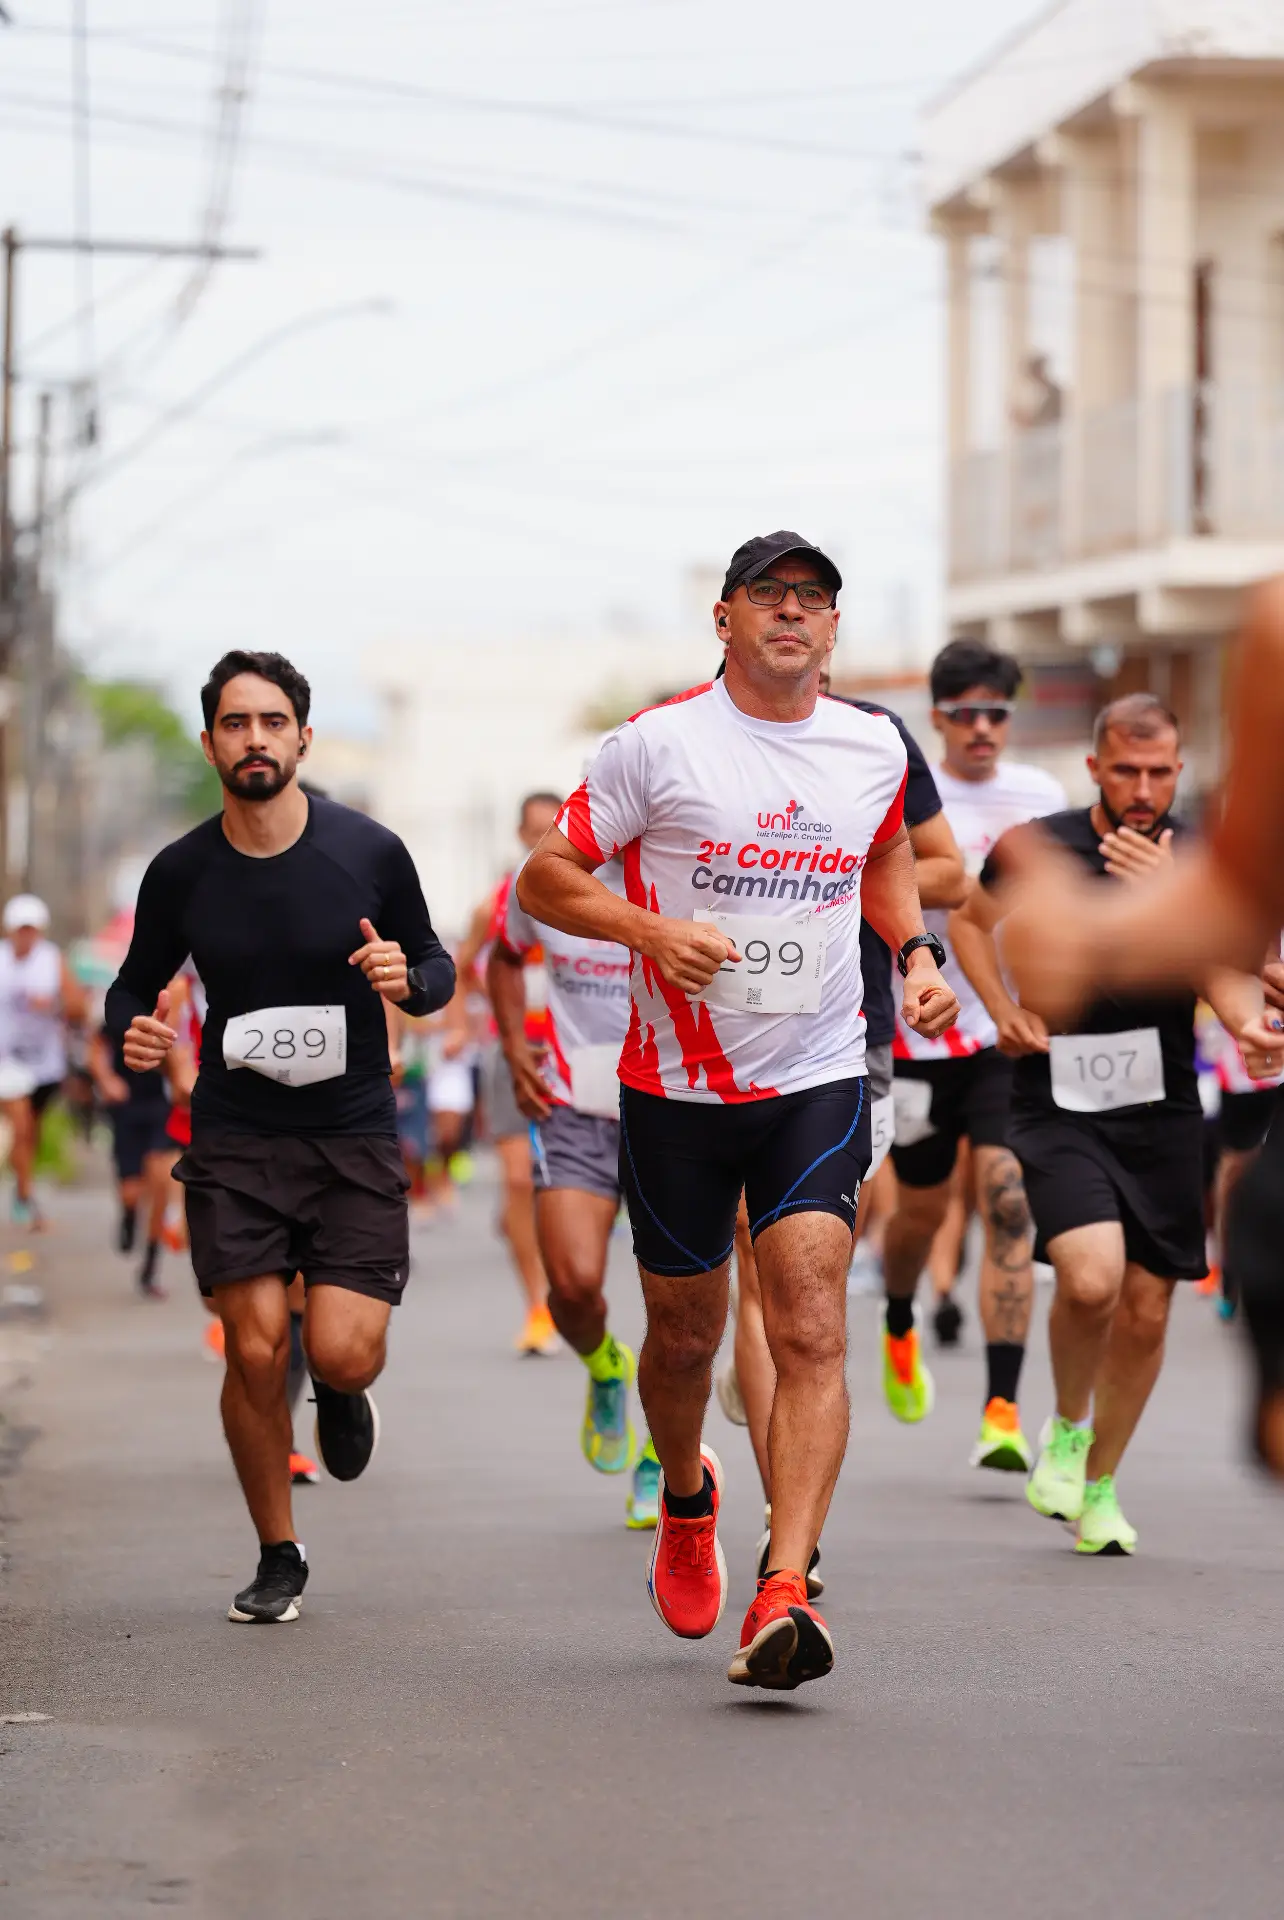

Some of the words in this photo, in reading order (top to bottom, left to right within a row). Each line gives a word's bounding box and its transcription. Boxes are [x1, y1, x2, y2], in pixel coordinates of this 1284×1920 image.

[770, 831, 793, 841] Felipe
[801, 833, 832, 842] Cruvinel
[737, 844, 859, 874] Corrida
[243, 1028, 326, 1060] 289
[1073, 1049, 1138, 1083] 107
